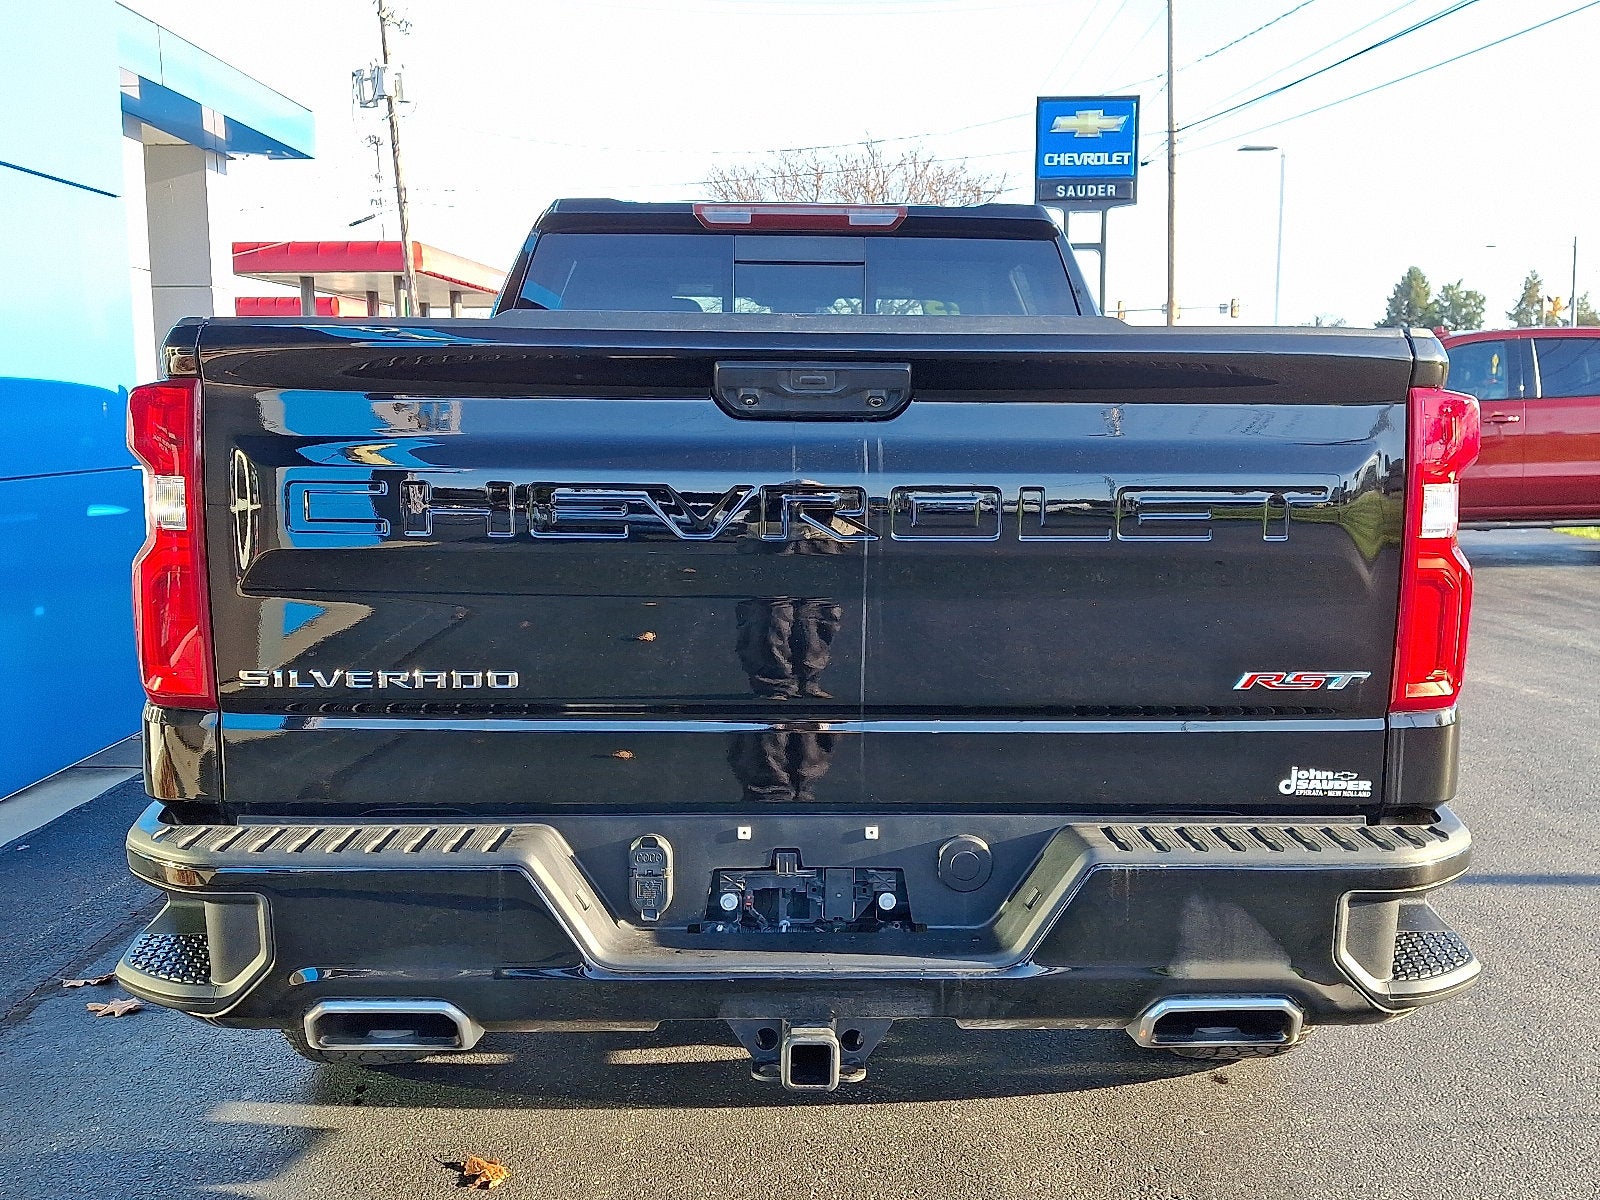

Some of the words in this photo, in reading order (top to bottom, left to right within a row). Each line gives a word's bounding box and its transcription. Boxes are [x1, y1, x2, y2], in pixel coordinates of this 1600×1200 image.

[1043, 152, 1132, 166] CHEVROLET
[1056, 184, 1116, 198] SAUDER
[283, 479, 1331, 542] CHEVROLET
[238, 669, 520, 689] SILVERADO
[1232, 671, 1372, 691] RST
[1296, 779, 1373, 791] SAUDER
[1295, 789, 1324, 797] EPHRATA
[1342, 790, 1372, 798] HOLLAND
